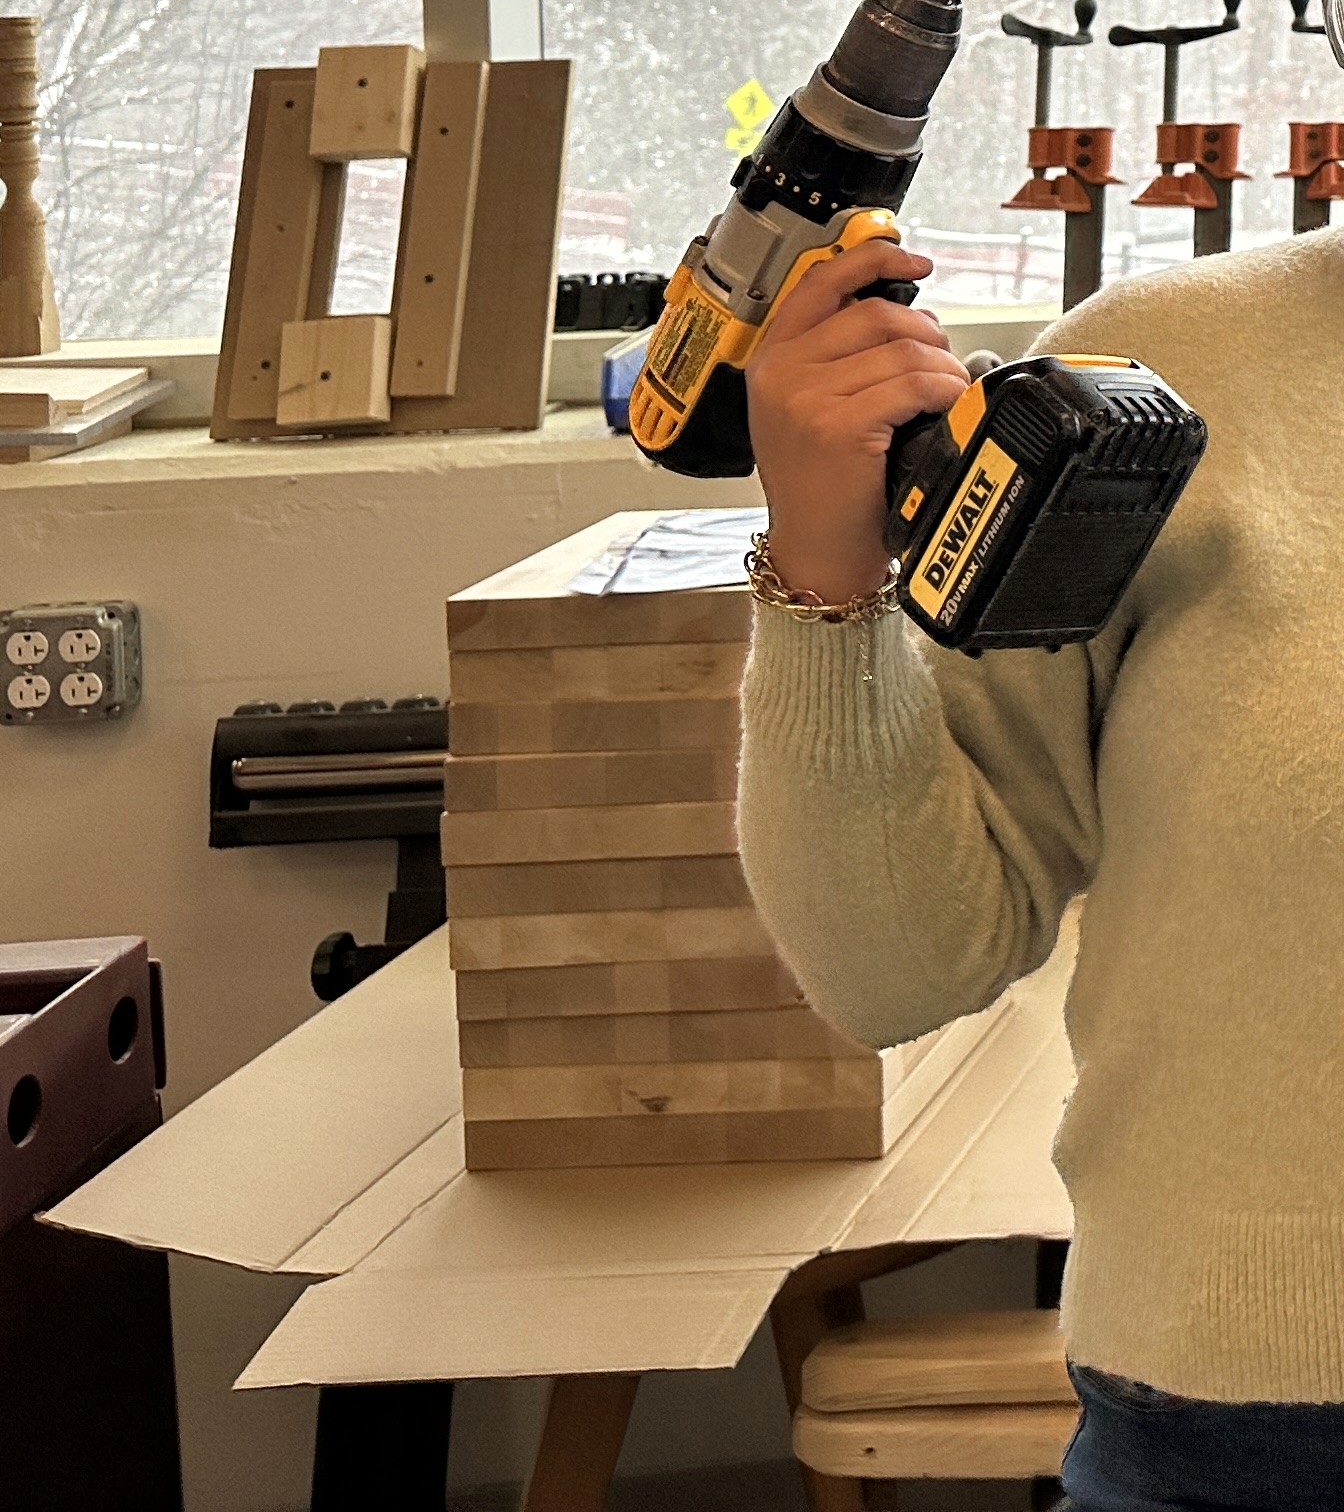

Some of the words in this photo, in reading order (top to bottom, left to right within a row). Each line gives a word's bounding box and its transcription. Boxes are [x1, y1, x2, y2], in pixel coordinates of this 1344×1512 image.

[774, 172, 786, 186] 3
[808, 191, 822, 205] 5
[924, 469, 996, 593] DEWALT
[958, 561, 980, 594] MAX
[978, 500, 1011, 558] LITHIUM
[1008, 475, 1025, 503] ION
